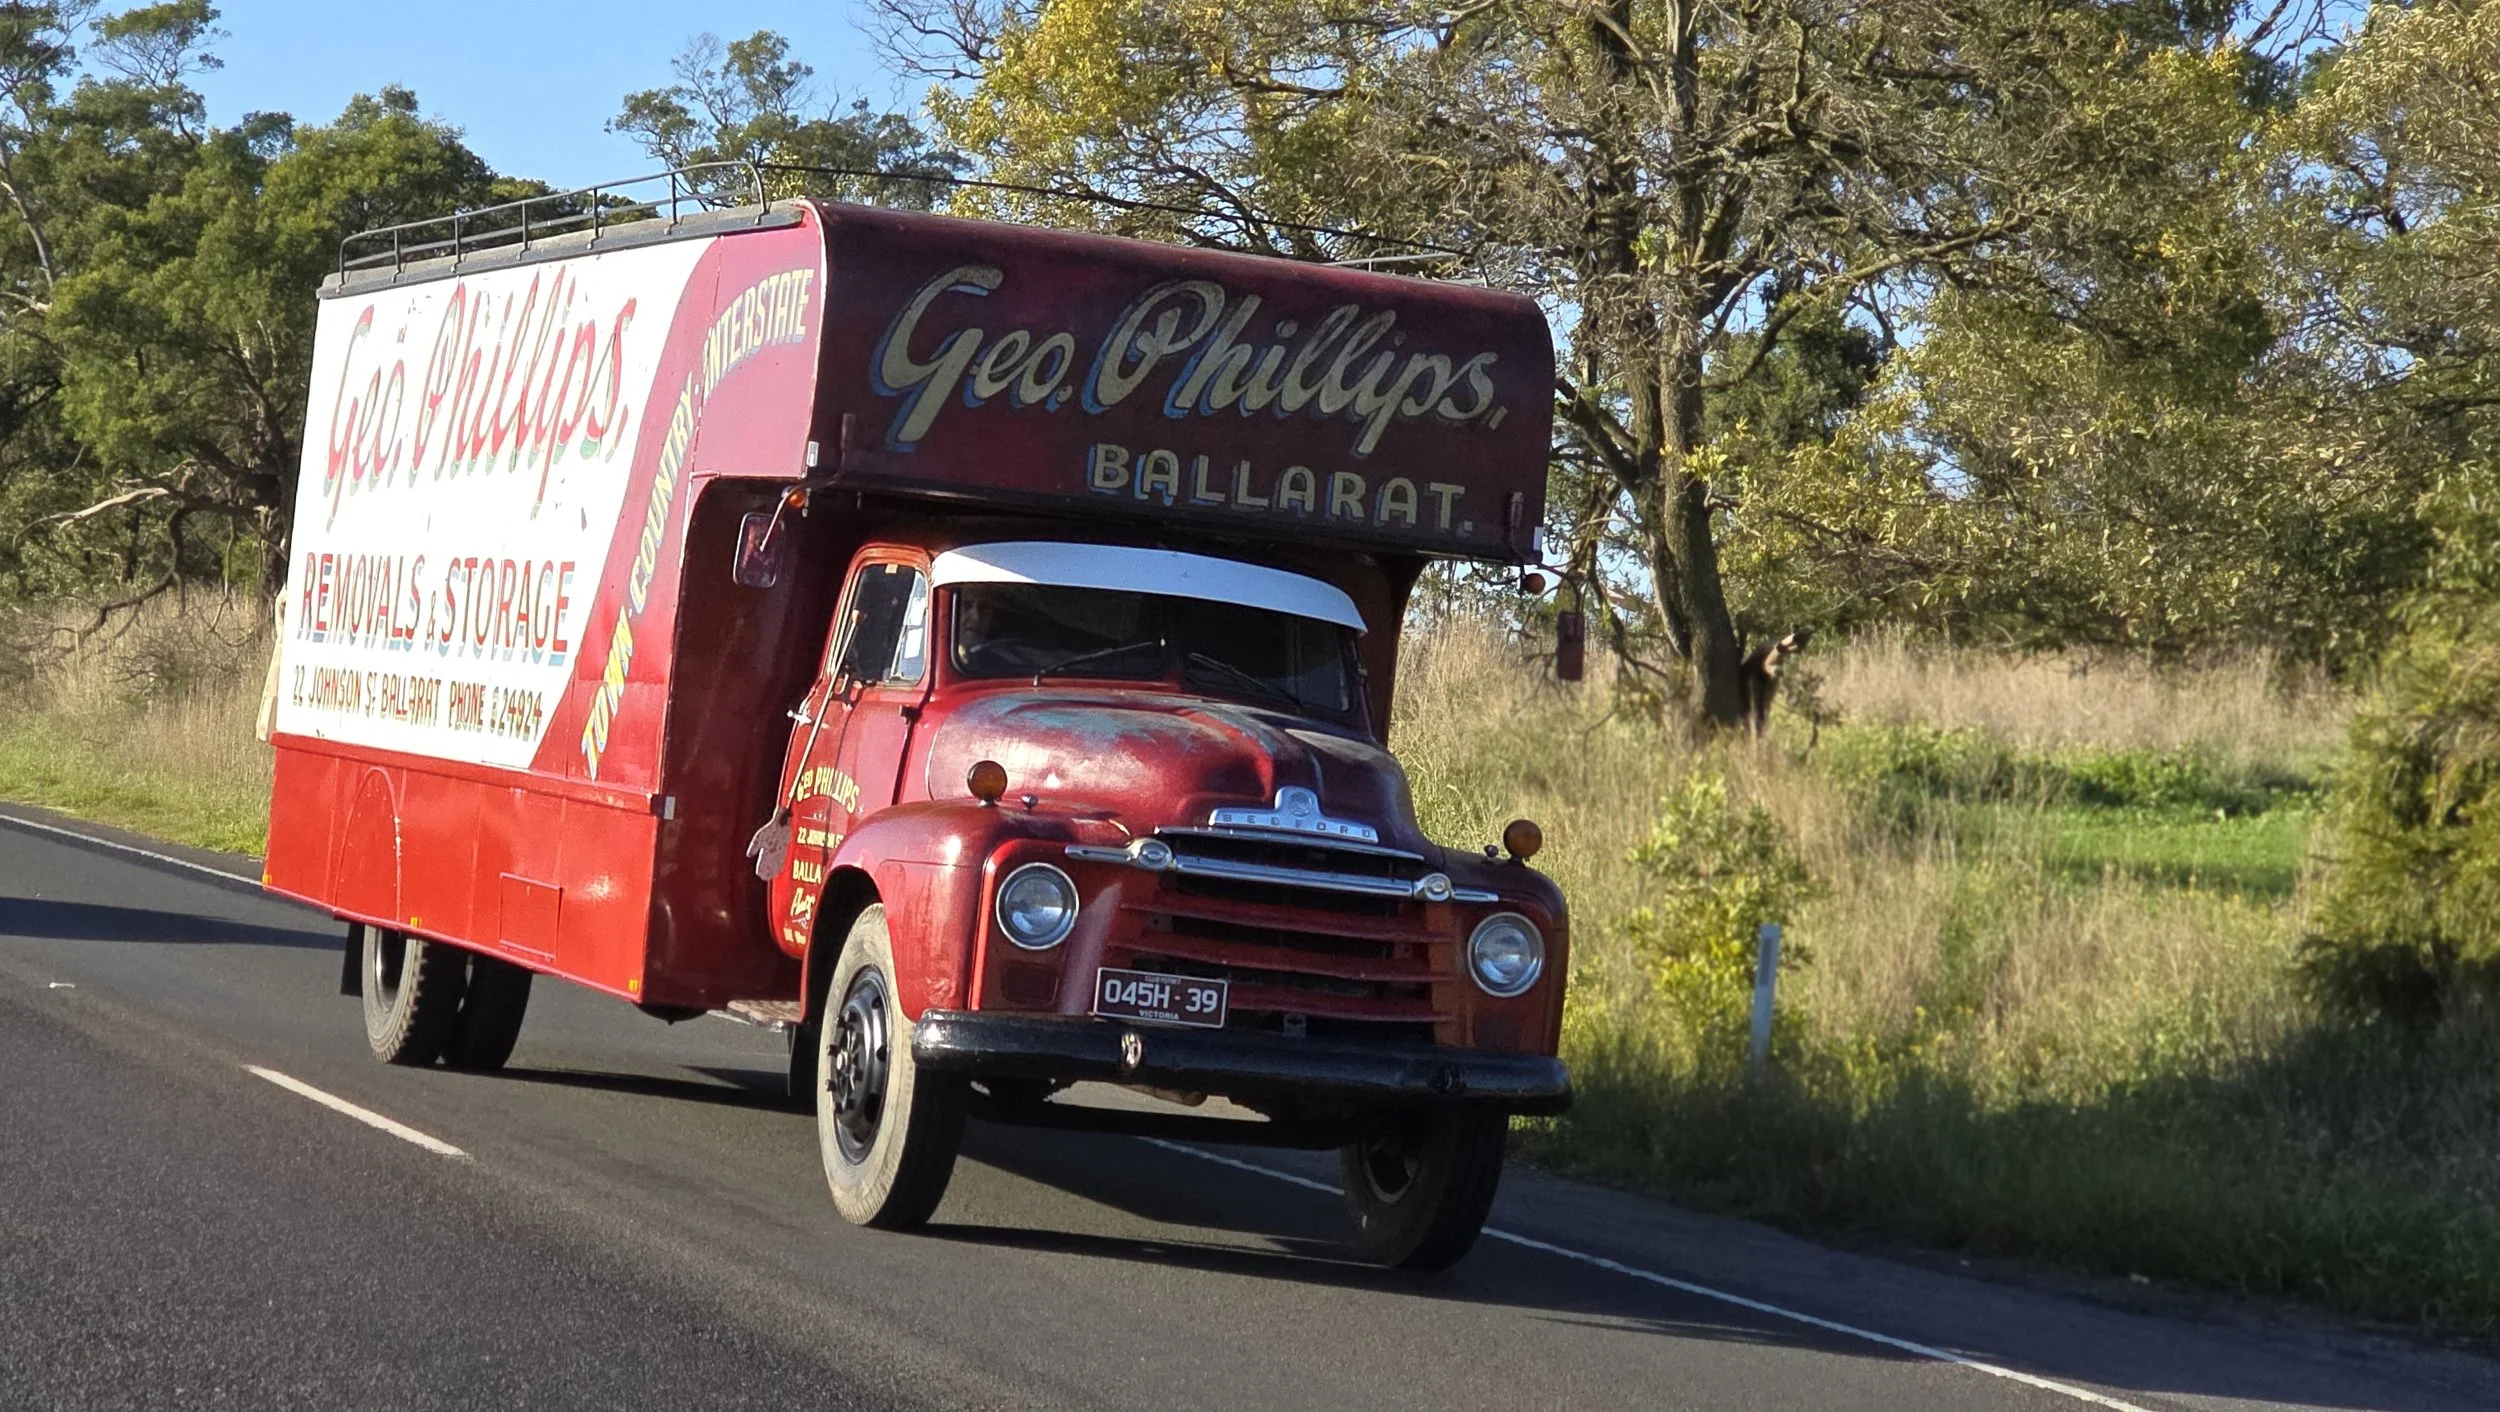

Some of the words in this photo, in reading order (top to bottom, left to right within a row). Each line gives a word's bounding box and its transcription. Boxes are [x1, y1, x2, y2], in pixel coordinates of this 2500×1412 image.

[874, 266, 1075, 447] Geo.
[581, 605, 633, 781] TOWN
[630, 371, 695, 614] COUNTRY
[703, 268, 815, 398] INTERSTATE
[300, 552, 425, 648] REMOVALS
[426, 590, 437, 645] &
[440, 557, 575, 662] STORAGE
[293, 664, 305, 704] 22
[309, 665, 361, 712] JOHNSON
[381, 673, 442, 726] BALLARAT
[448, 680, 486, 729] PHONE
[1223, 813, 1371, 838] BEDFORD
[1139, 1009, 1179, 1020] VICTORIA
